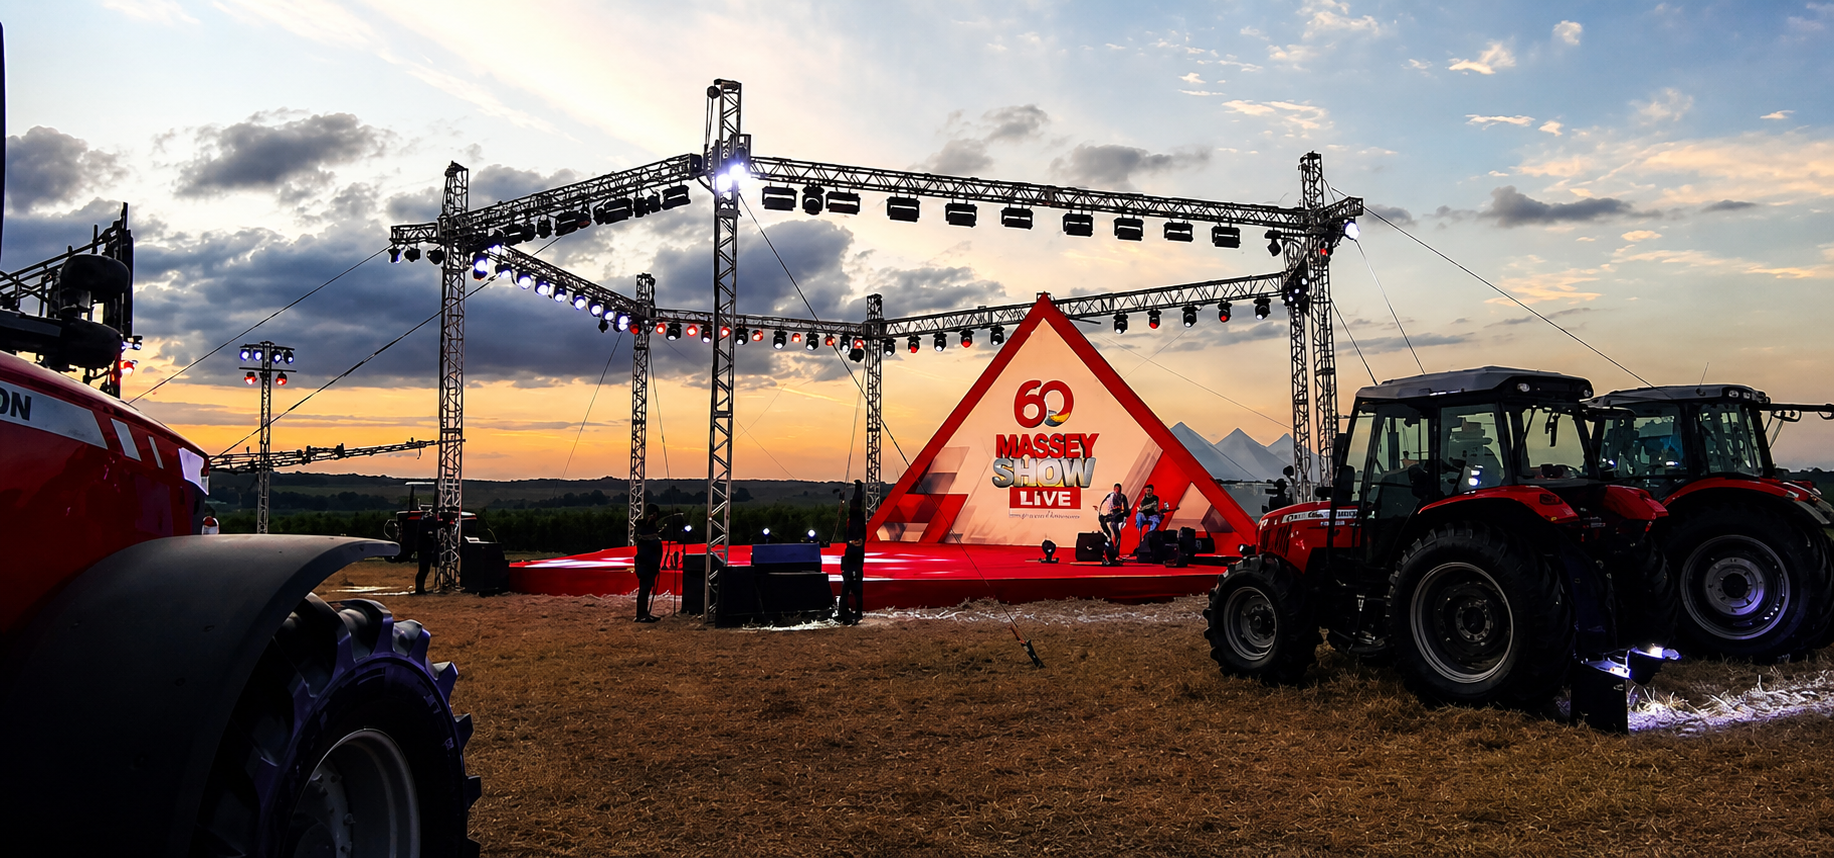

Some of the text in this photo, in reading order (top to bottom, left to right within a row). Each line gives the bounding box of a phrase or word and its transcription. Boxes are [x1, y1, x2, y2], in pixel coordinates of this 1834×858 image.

[1014, 380, 1074, 428] 60
[996, 433, 1099, 458] MASSEY
[992, 458, 1096, 488] SHOW
